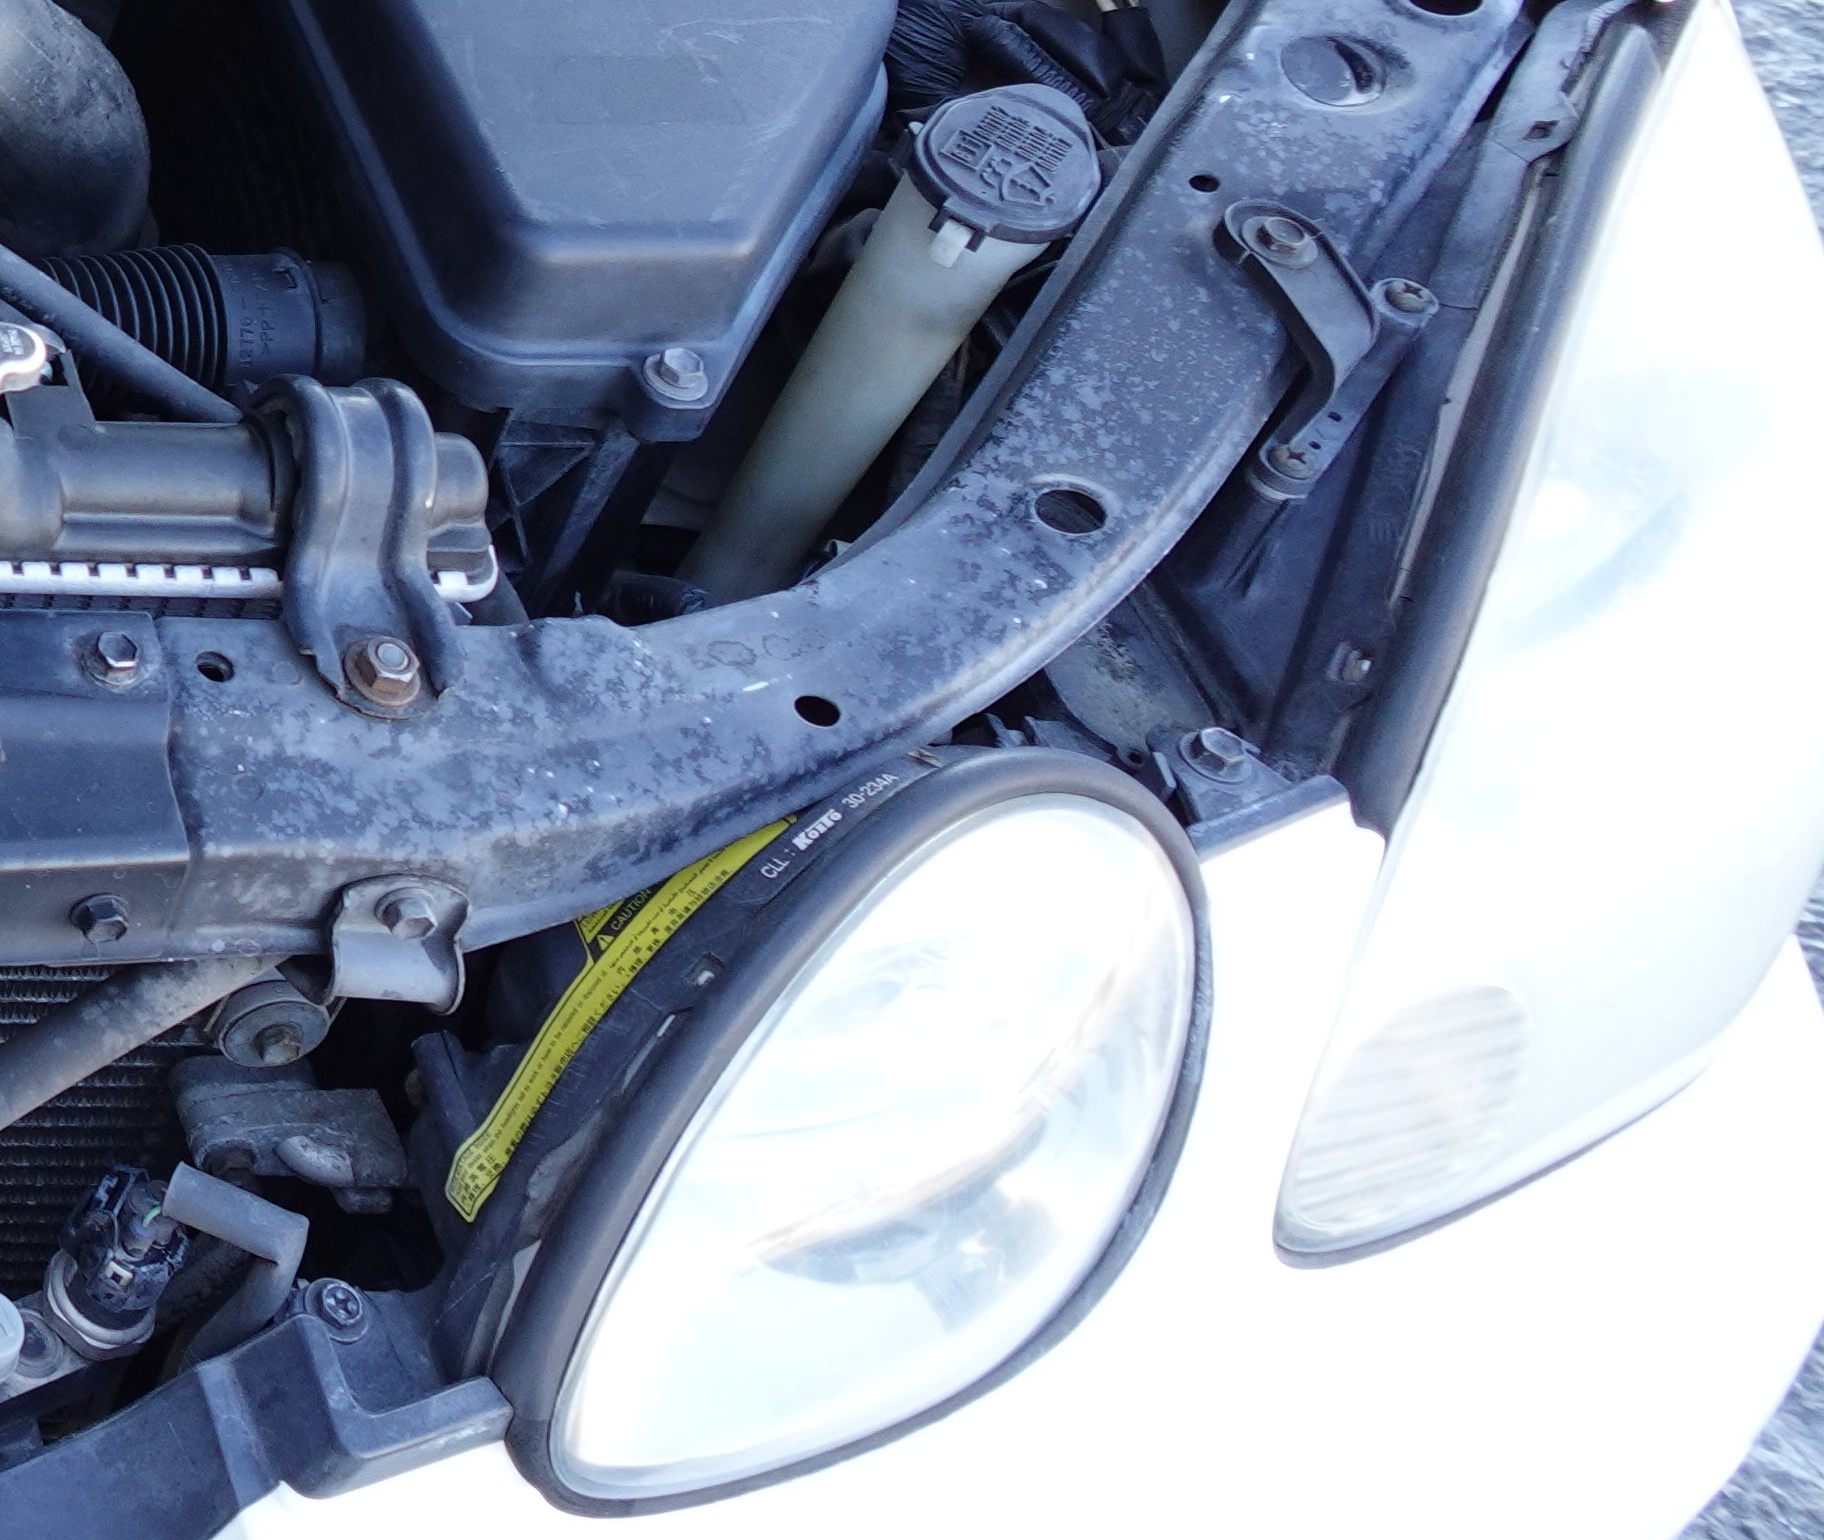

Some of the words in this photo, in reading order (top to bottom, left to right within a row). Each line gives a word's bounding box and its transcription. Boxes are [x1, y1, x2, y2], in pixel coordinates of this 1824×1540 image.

[760, 858, 790, 878] CLL
[841, 773, 899, 809] 30-234A
[610, 887, 652, 931] CAUTION
